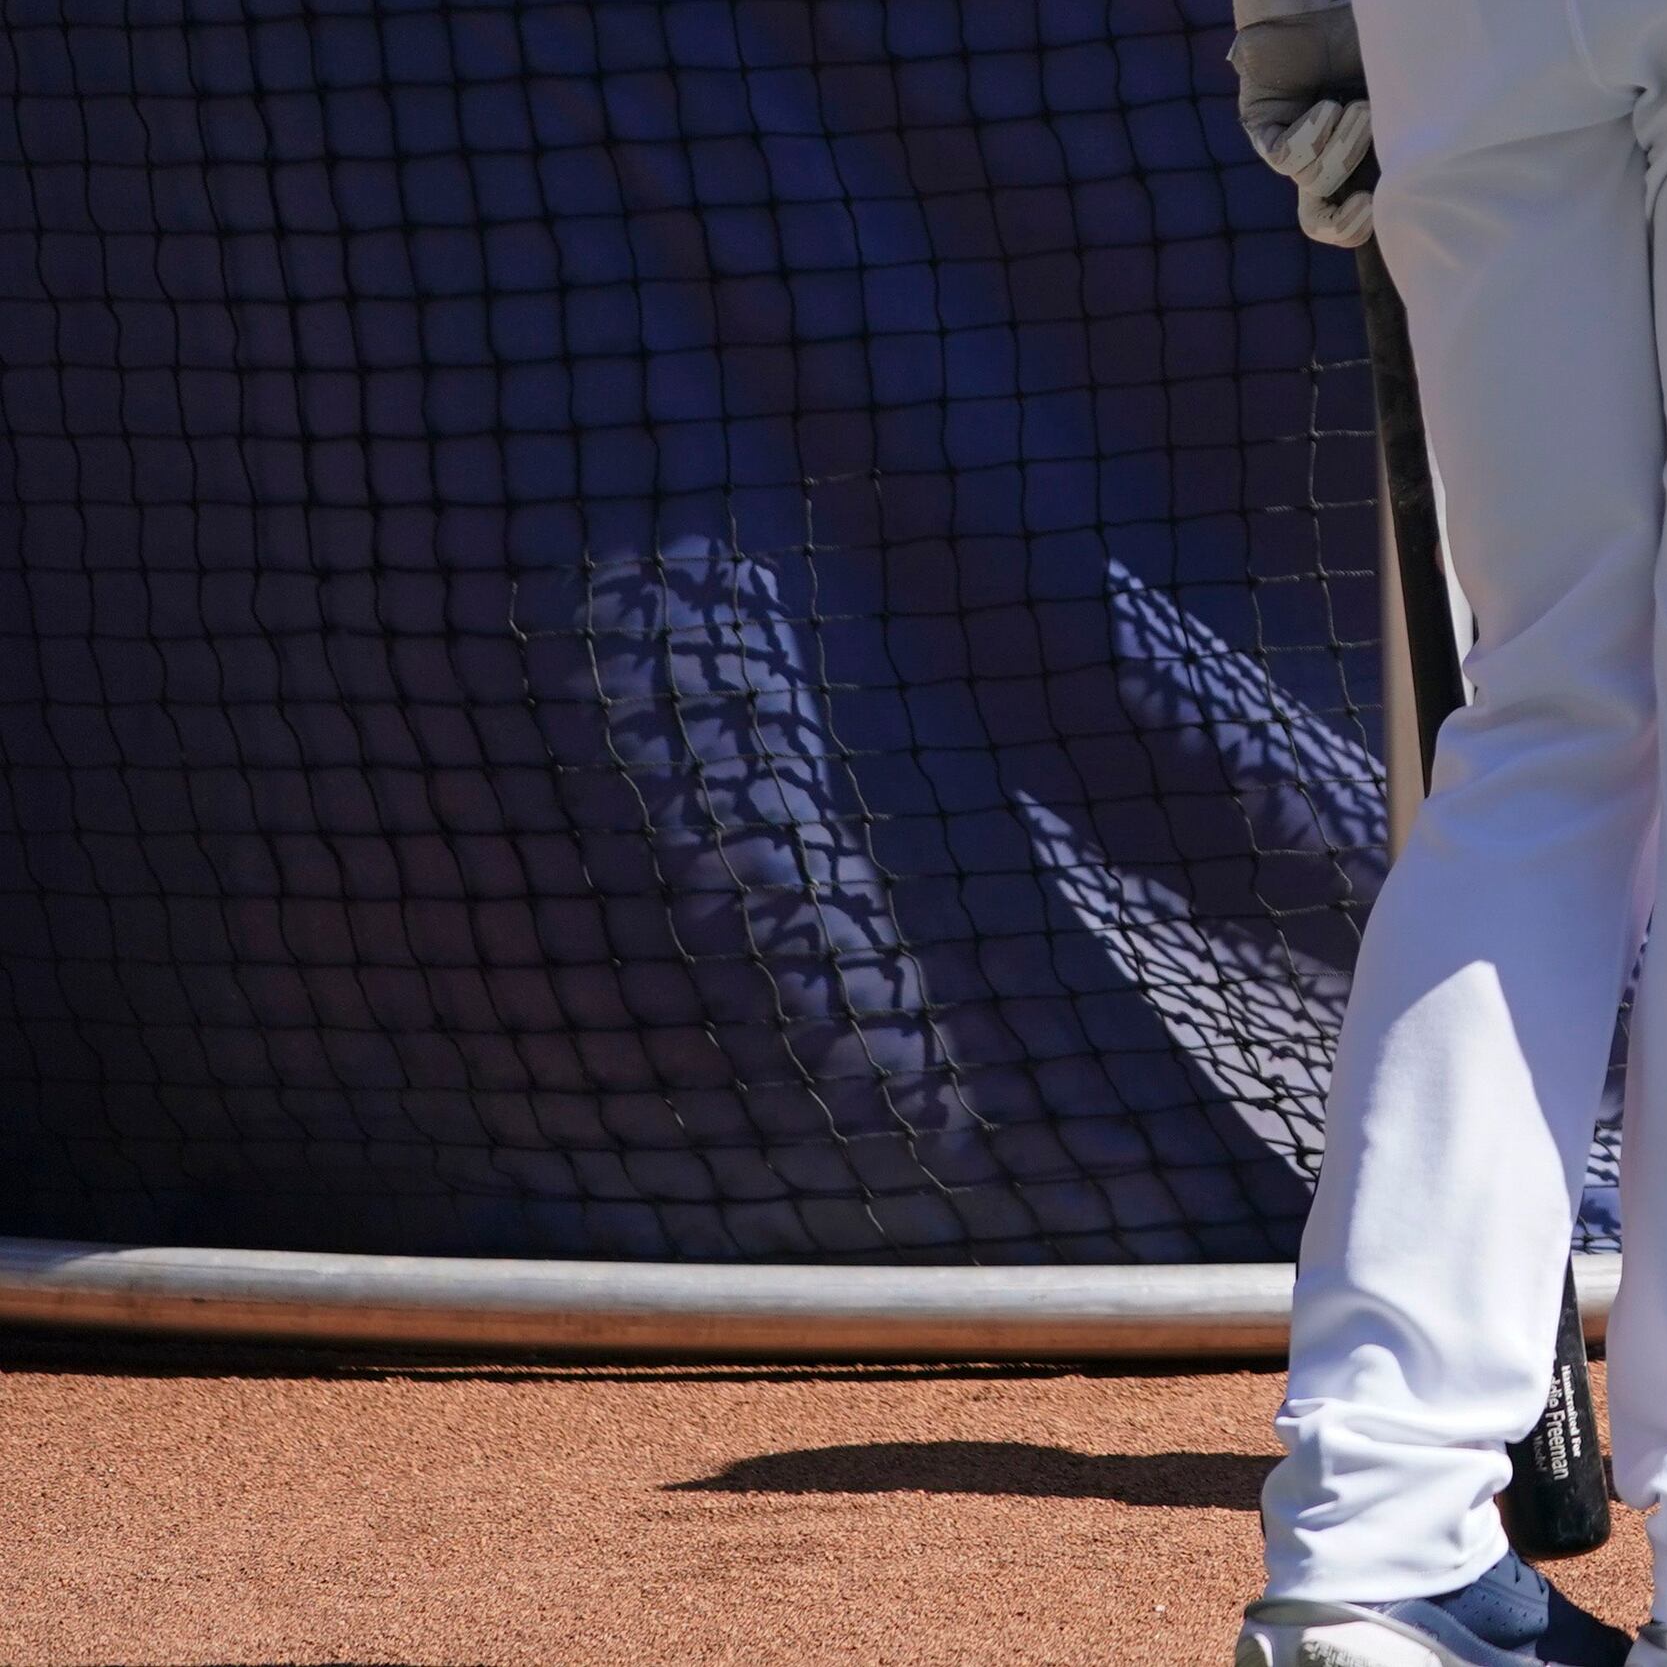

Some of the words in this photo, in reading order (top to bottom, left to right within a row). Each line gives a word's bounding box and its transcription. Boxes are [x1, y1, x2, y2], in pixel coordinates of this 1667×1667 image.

[1545, 1409, 1569, 1481] Freeman
[1561, 1364, 1580, 1436] Handcrafted
[1571, 1436, 1582, 1458] For
